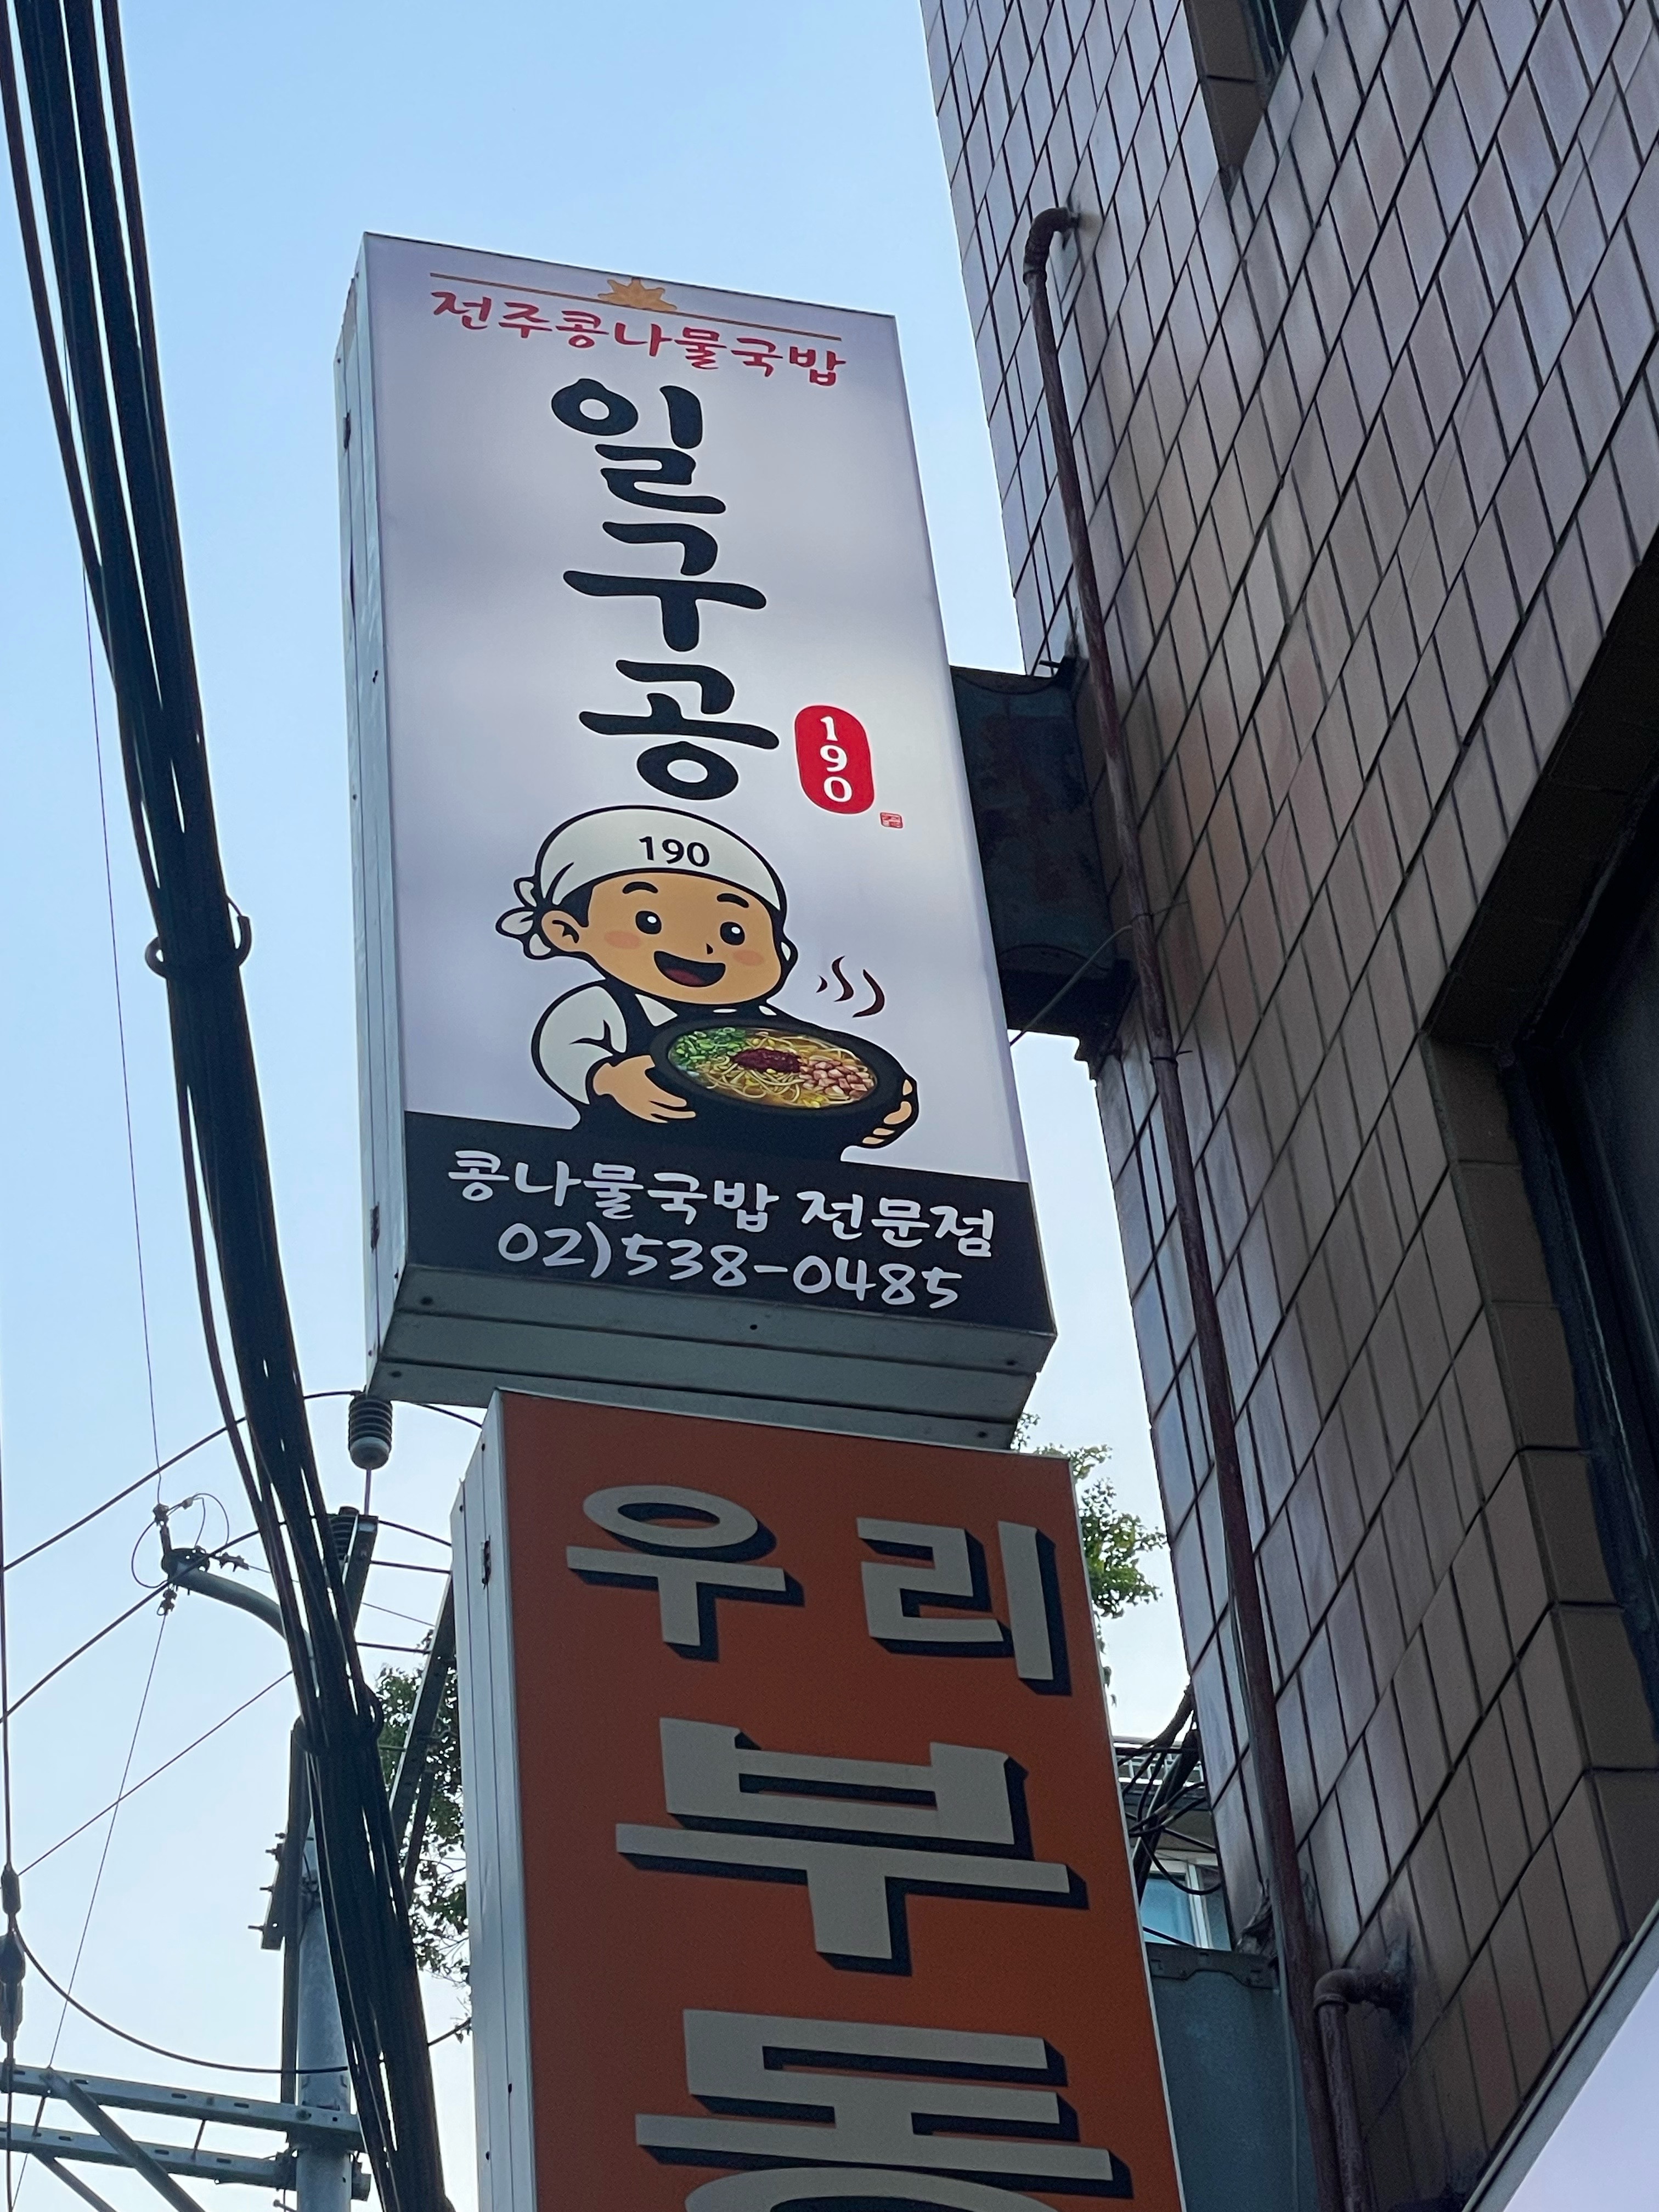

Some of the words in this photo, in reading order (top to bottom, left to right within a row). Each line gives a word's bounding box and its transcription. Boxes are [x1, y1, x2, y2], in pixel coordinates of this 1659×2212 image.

[431, 290, 847, 386] 전주콩나물국밥
[551, 378, 780, 800] 일구공
[820, 716, 853, 803] 190
[639, 836, 710, 867] 190
[448, 1150, 779, 1232] 콩나물국밥
[795, 1190, 995, 1257] 전문점
[498, 1221, 962, 1309] 02)538-0485
[566, 1485, 1072, 1695] 우리
